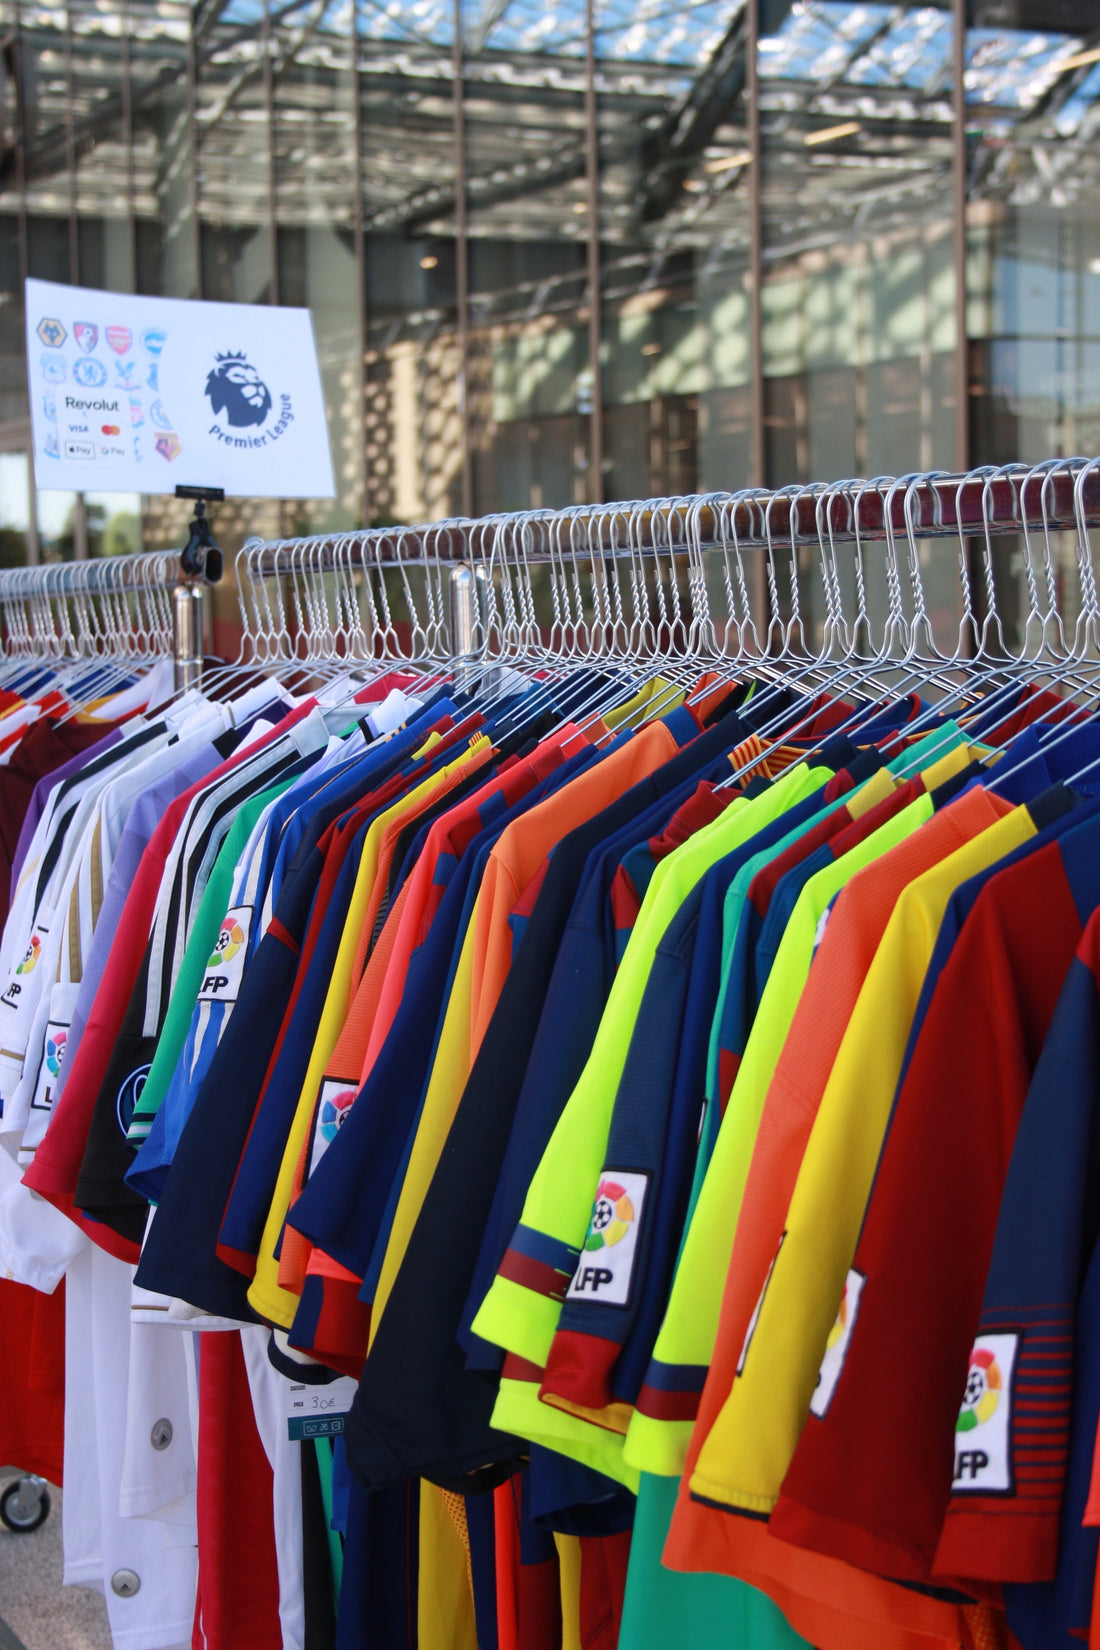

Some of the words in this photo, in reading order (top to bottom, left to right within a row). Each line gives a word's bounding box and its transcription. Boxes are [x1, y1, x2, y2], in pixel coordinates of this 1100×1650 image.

[65, 396, 120, 412] Revolut
[69, 424, 89, 433] VISA
[208, 425, 268, 449] Premier
[266, 394, 295, 440] League
[76, 446, 91, 455] Pay
[111, 447, 125, 456] Pay
[7, 982, 22, 998] FP
[200, 976, 229, 993] FP
[311, 1396, 336, 1409] 30€
[955, 1450, 989, 1479] FP
